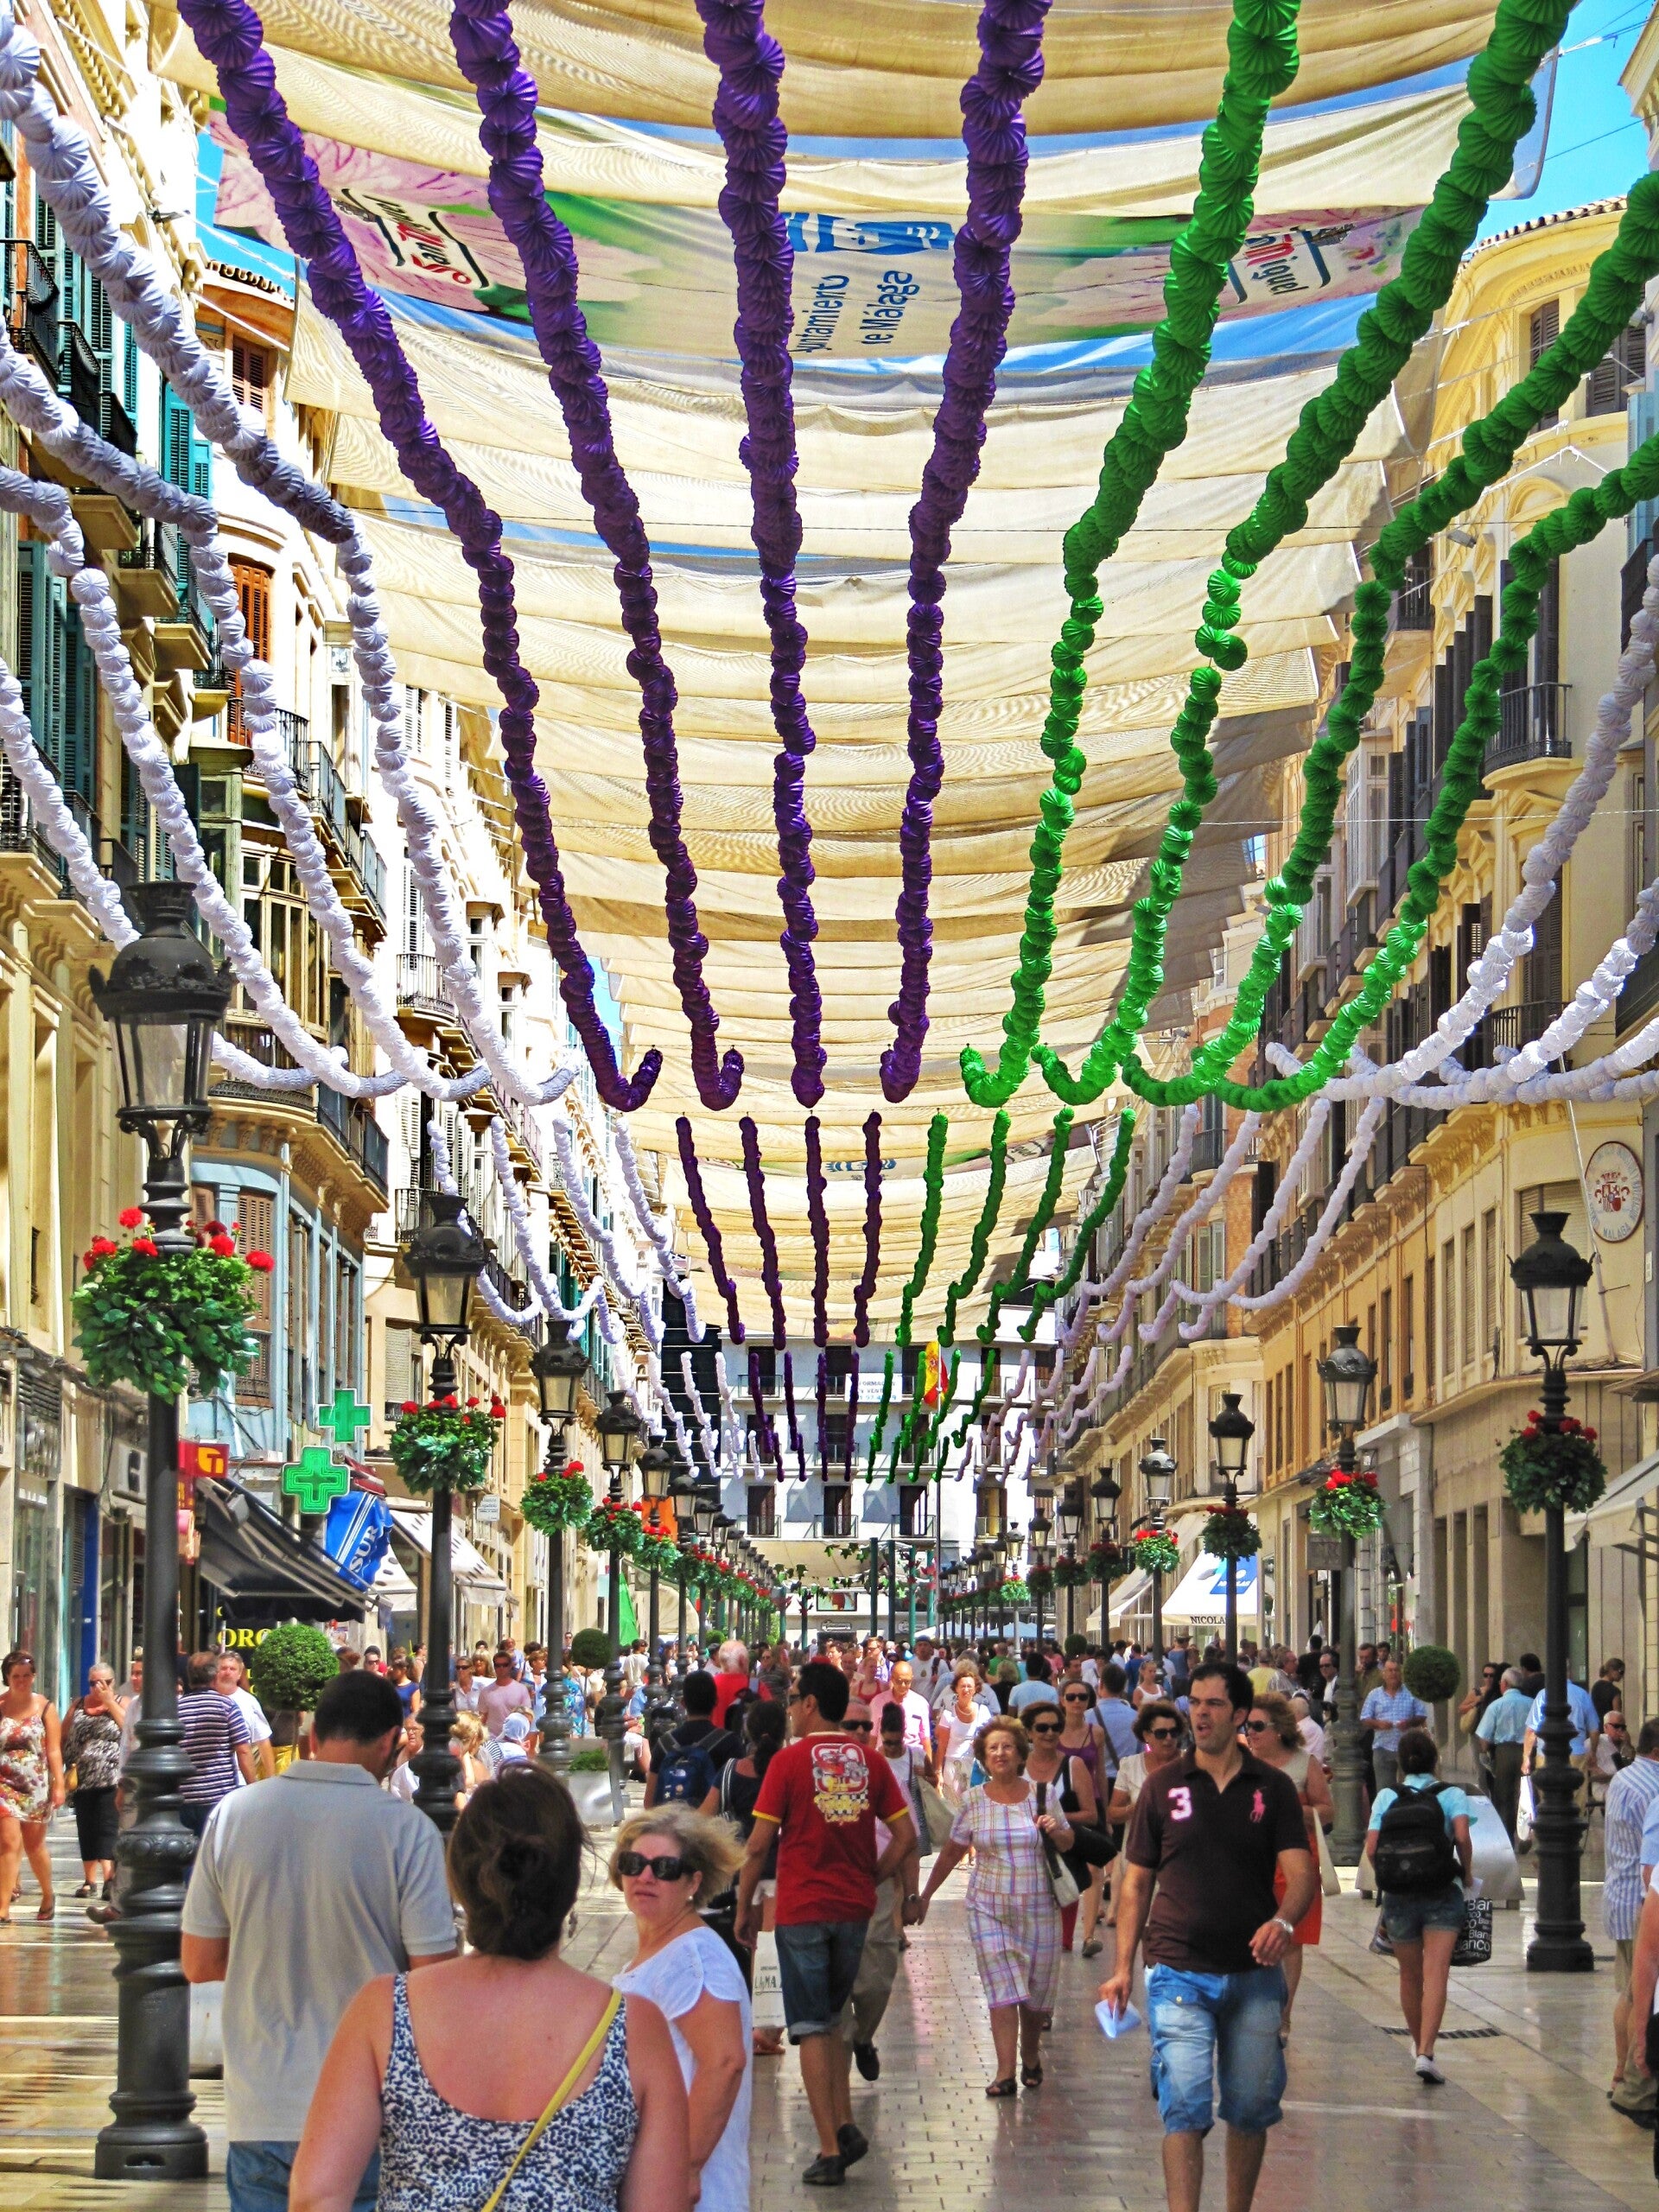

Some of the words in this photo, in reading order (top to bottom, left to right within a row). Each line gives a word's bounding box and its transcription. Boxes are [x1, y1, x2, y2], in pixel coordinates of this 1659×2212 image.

[349, 1525, 378, 1573] SUR
[1190, 1616, 1226, 1624] NICOLA
[1167, 1786, 1192, 1821] 3
